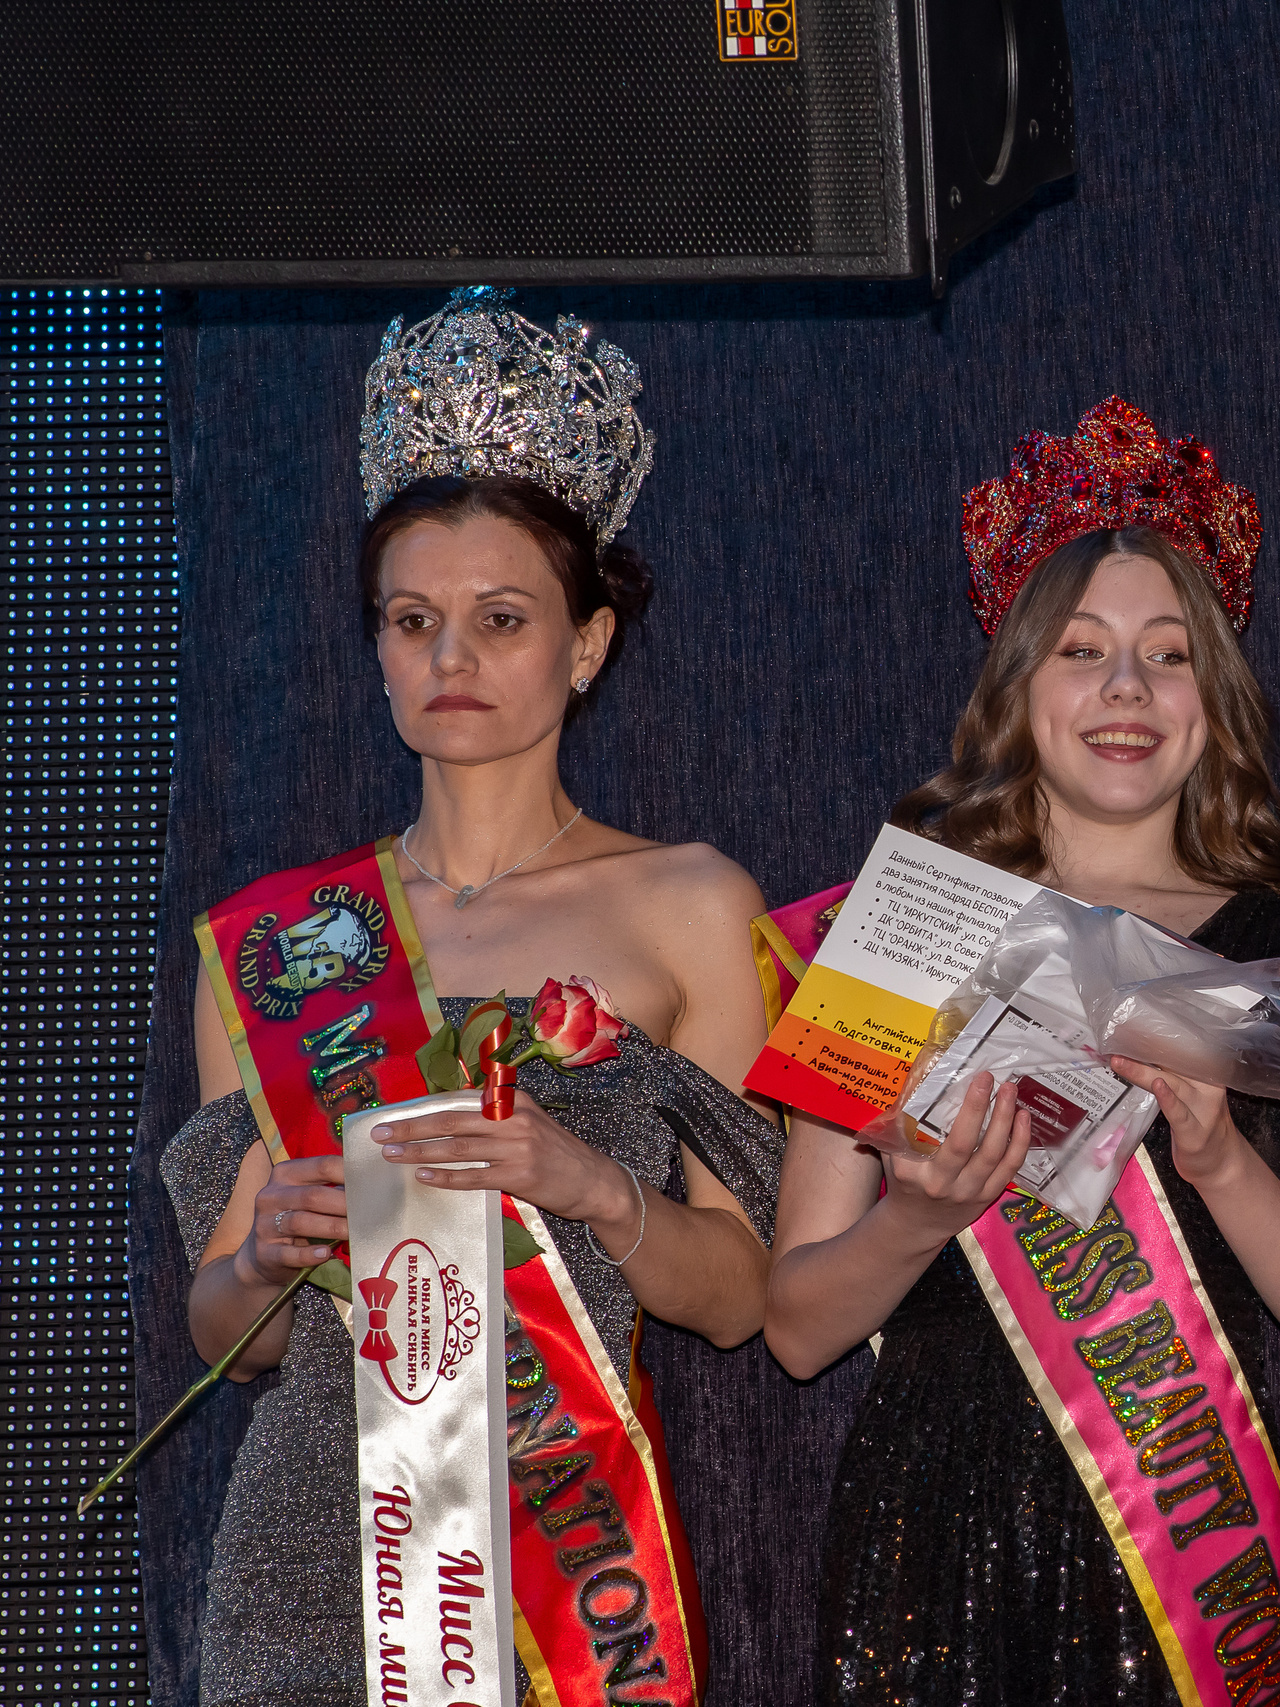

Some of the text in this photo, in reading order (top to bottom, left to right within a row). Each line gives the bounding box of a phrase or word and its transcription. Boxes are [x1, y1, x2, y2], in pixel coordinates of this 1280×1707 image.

[881, 866, 900, 879] два
[901, 872, 938, 893] занятия
[938, 888, 972, 909] подряд
[889, 850, 1023, 910] Данный Сертификат позволяе
[875, 880, 1000, 935] в любом из наших филиалов
[878, 913, 893, 926] ДК
[887, 899, 901, 914] ТЦ
[978, 935, 994, 948] Со
[278, 930, 304, 996] WORLD BEAUTY
[314, 885, 389, 992] GRAND-PRIX
[863, 940, 880, 955] ДЦ
[925, 964, 964, 986] Иркутск
[872, 927, 887, 941] ТЦ
[944, 955, 975, 975] Волжс
[240, 913, 303, 1017] GRAND-PRIX
[834, 1020, 912, 1058] Подготовка к
[862, 1018, 927, 1047] Английский
[808, 1057, 900, 1097] Авиа-моделиро
[820, 1046, 888, 1080] Развивашки
[838, 1083, 892, 1111] Робототе
[407, 1255, 418, 1391] ВЕЛИКАЯ СИБИРЬ
[421, 1277, 431, 1371] ЮНАЯ МИСС
[1080, 1302, 1255, 1548] BEAUTY
[373, 1484, 413, 1707] Юная ми
[437, 1549, 485, 1689] Мисс
